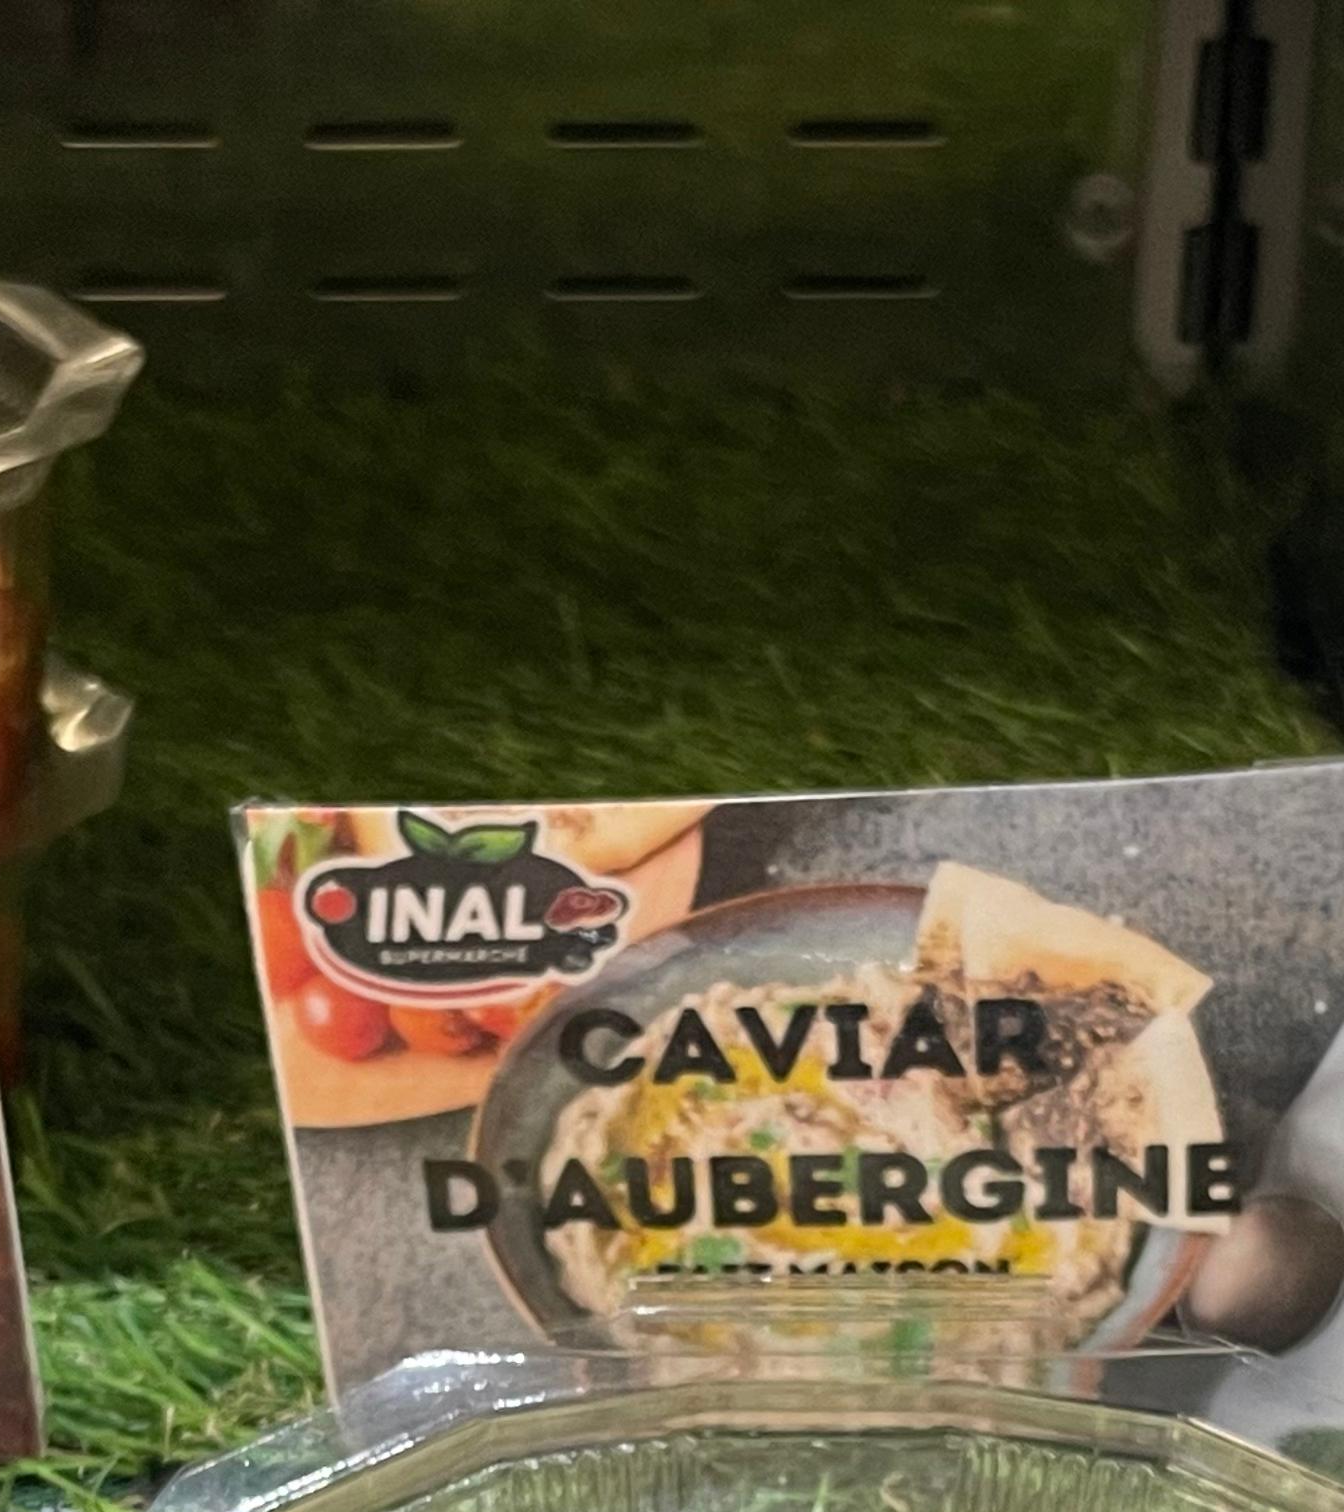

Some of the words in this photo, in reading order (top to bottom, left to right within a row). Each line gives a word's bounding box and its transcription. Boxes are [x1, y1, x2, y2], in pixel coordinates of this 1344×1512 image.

[367, 883, 545, 944] INAL
[557, 996, 1053, 1088] CAVIAR
[422, 1142, 1251, 1234] D'AUBERGINE
